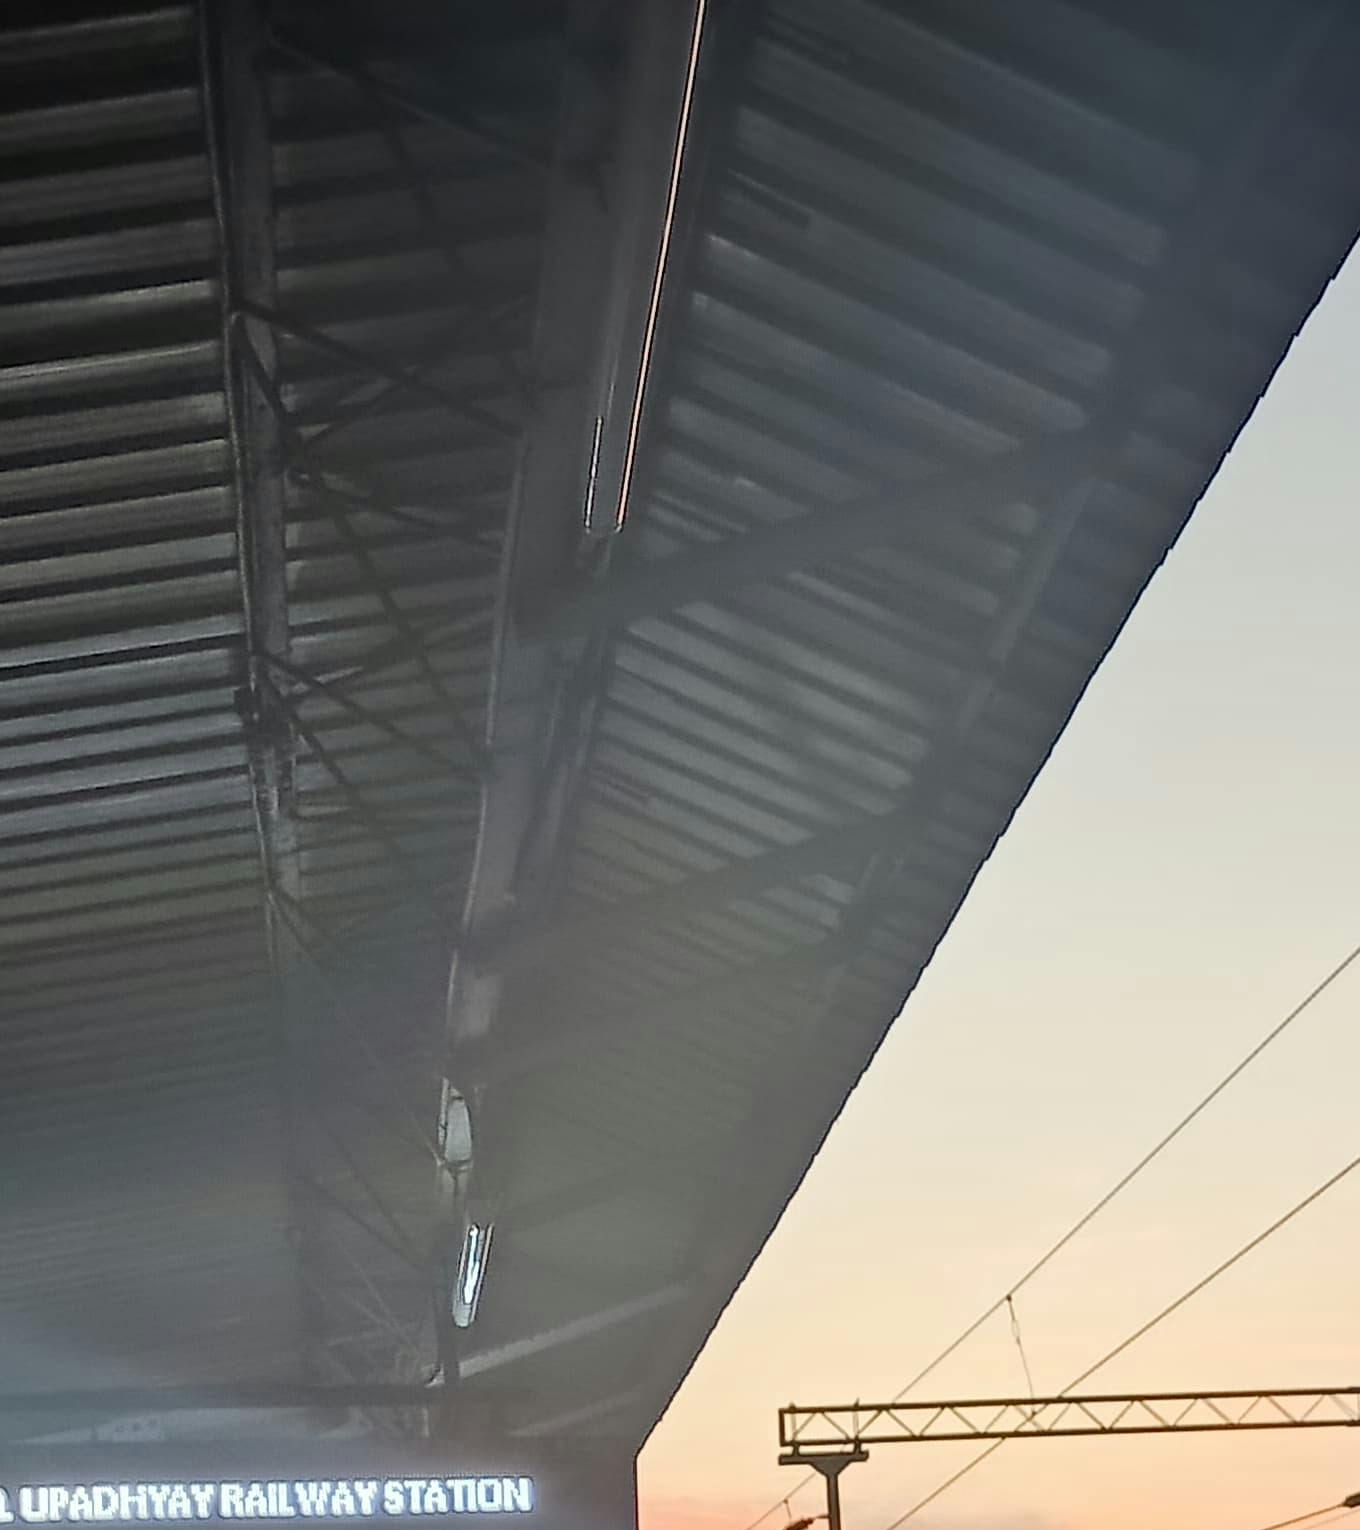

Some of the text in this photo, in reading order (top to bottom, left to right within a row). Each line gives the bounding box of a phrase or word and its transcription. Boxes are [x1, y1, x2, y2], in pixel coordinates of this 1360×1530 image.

[19, 1481, 216, 1523] UPADHYAY
[219, 1479, 378, 1518] RAILWAY
[384, 1476, 533, 1515] STATION
